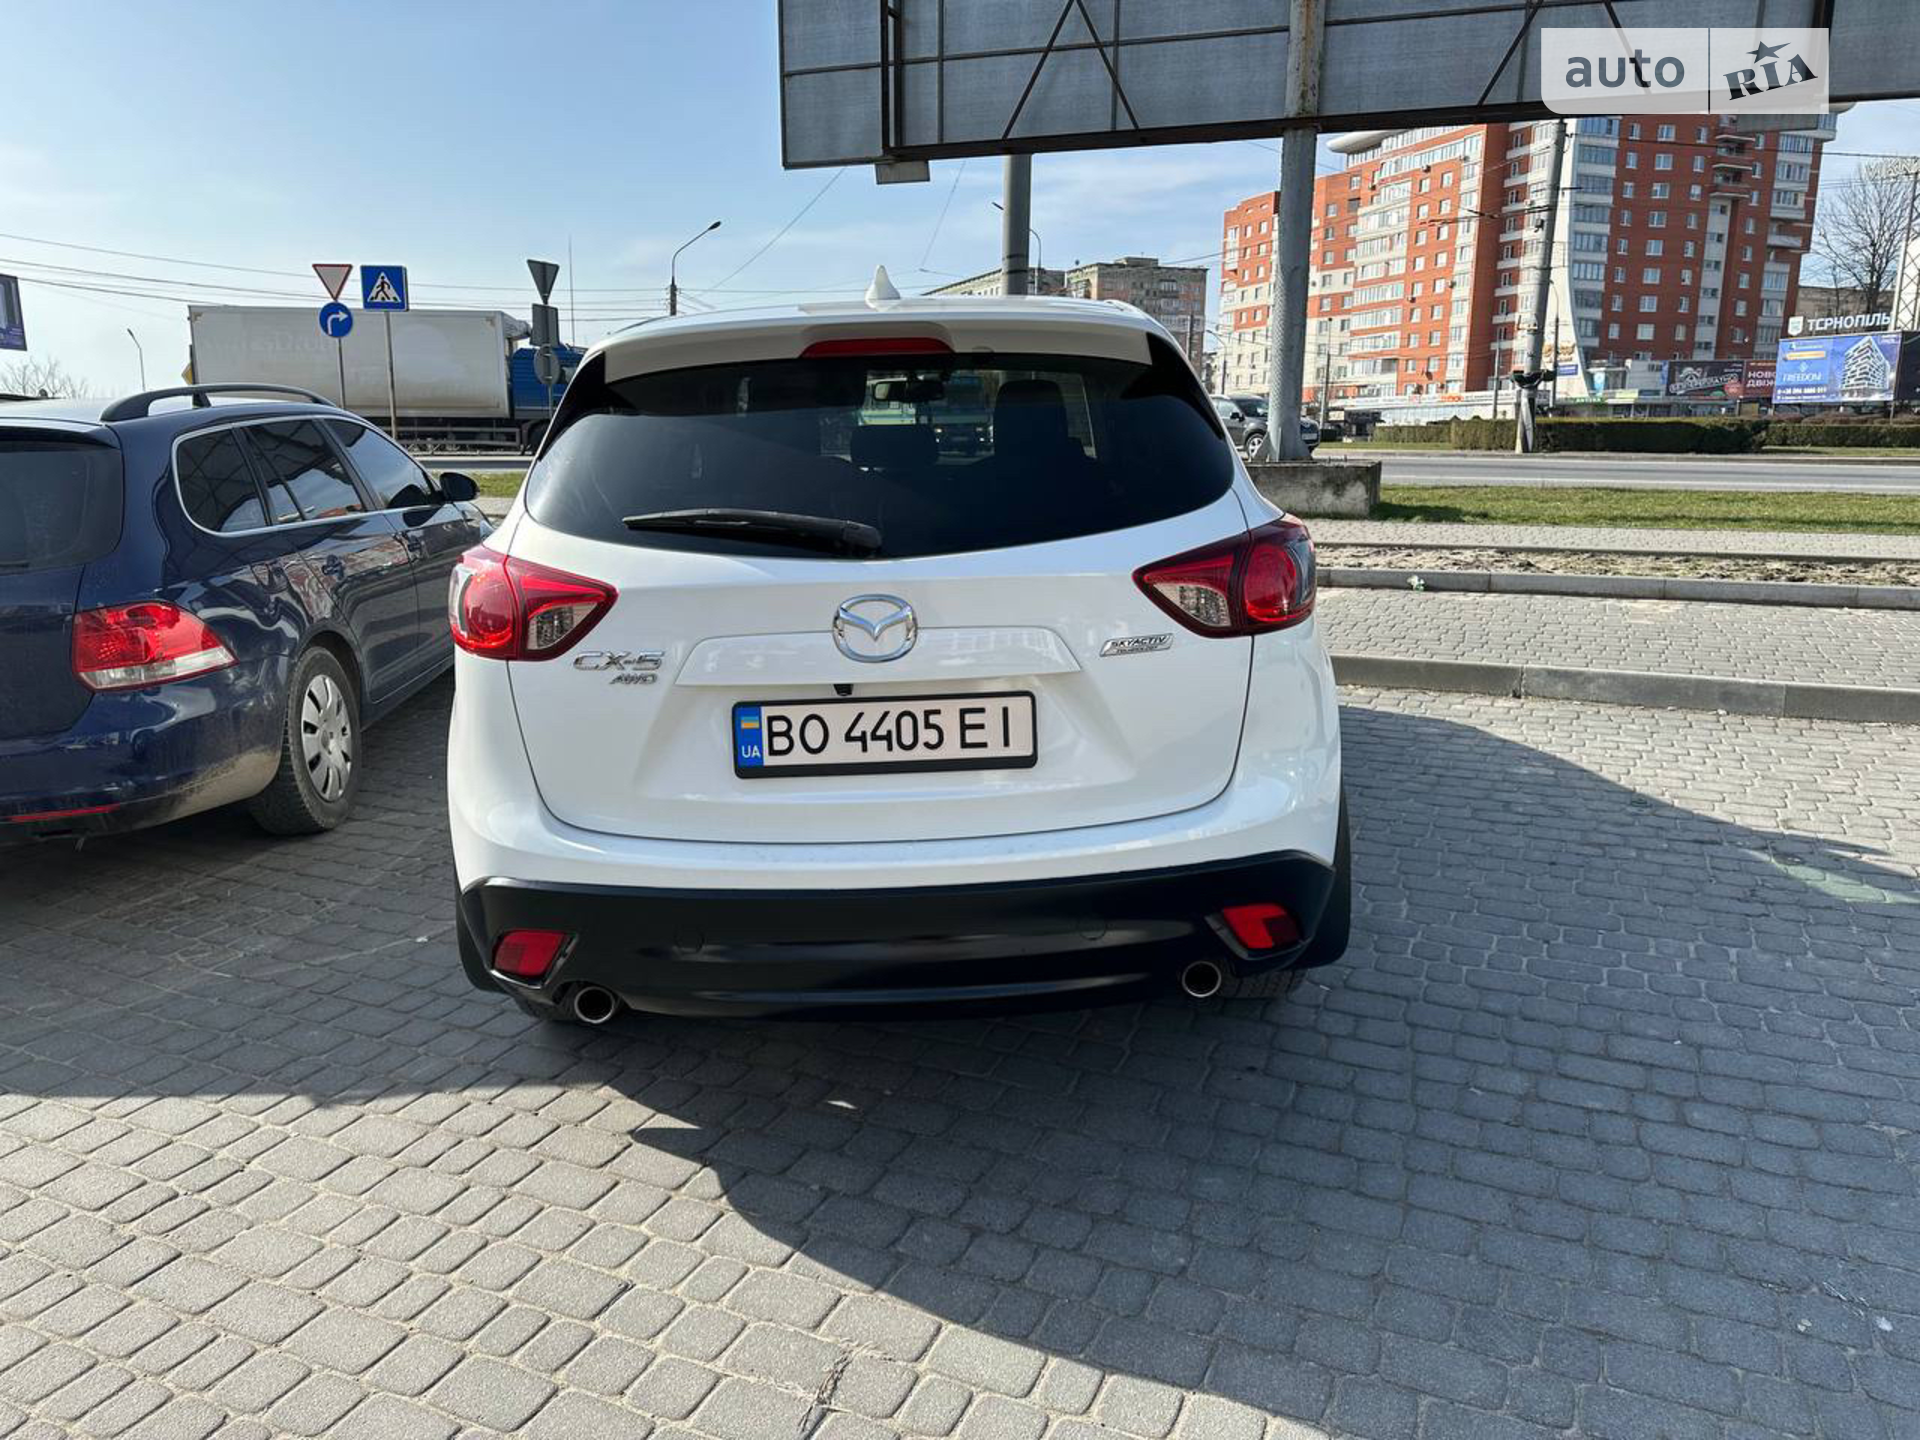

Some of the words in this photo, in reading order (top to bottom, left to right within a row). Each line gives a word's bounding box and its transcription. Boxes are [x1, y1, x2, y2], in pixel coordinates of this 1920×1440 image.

[1109, 634, 1168, 649] SKYACTIV
[573, 651, 665, 671] CX-5
[608, 673, 659, 685] AWD
[766, 713, 830, 757] BO
[844, 709, 944, 753] 4405
[741, 744, 761, 759] UA
